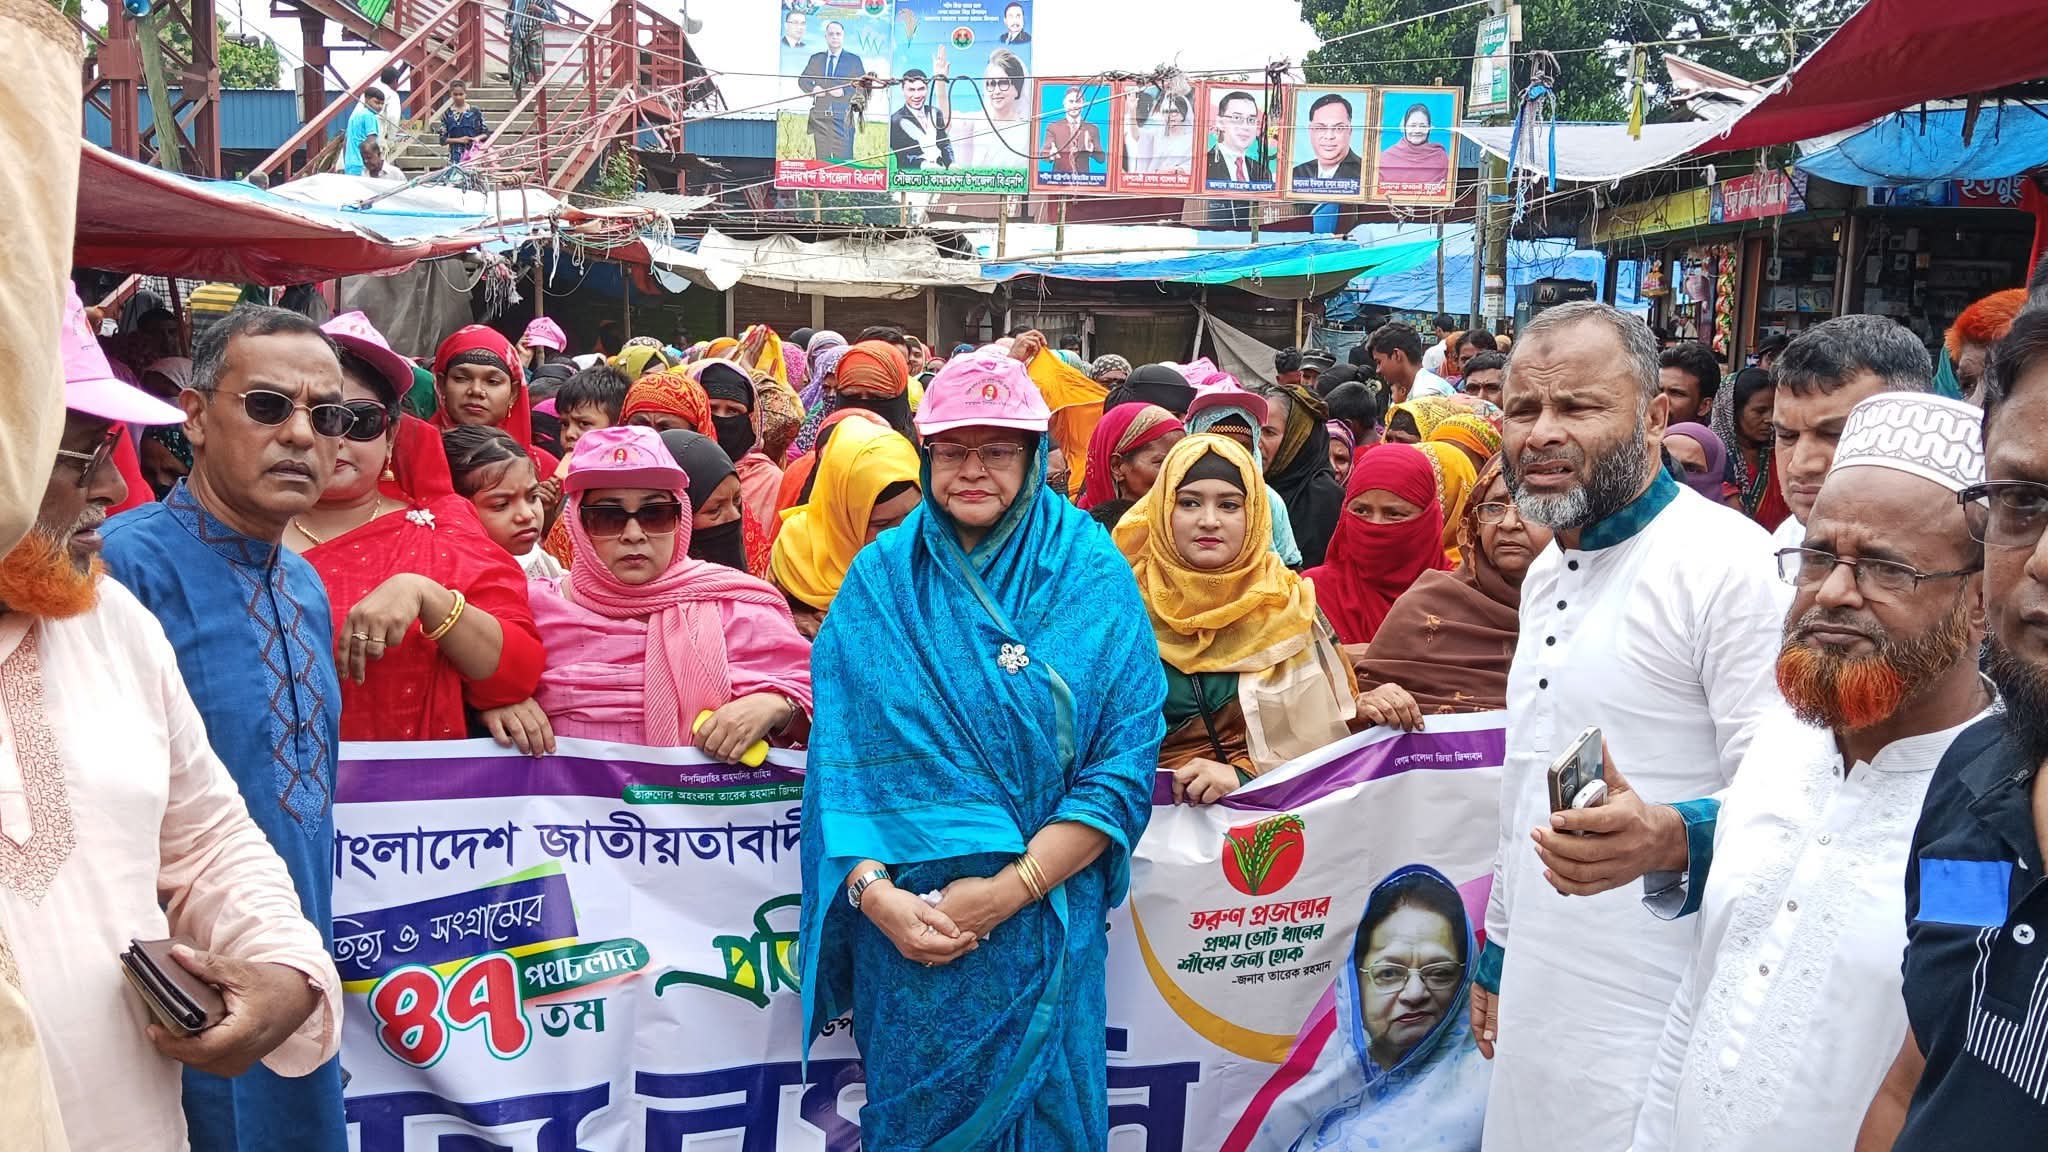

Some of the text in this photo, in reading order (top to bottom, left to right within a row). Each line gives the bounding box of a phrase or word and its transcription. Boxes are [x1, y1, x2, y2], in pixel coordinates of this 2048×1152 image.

[818, 168, 852, 186] উপজেলা
[854, 169, 885, 187] বিএনপি
[965, 171, 996, 187] উপজেলা
[997, 171, 1025, 188] বিএনপি
[632, 788, 673, 800] তারুণ্যের
[677, 790, 714, 801] অহংকার
[719, 790, 747, 801] তারেক
[750, 787, 776, 800] রহমান
[334, 820, 522, 881] াংলাদেশ
[1187, 896, 1332, 932] তরুণ প্রজন্মের
[332, 894, 546, 970] তিহ্য ও সংগ্রামের
[1202, 922, 1326, 953] প্রথম ভোট ধানের
[524, 946, 638, 990] পথচলার
[1176, 944, 1305, 975] শীষের জন্য হোক
[1267, 967, 1302, 982] তারেক
[1303, 960, 1333, 977] রহমান
[370, 952, 531, 1067] ৪৭
[535, 997, 608, 1038] তম
